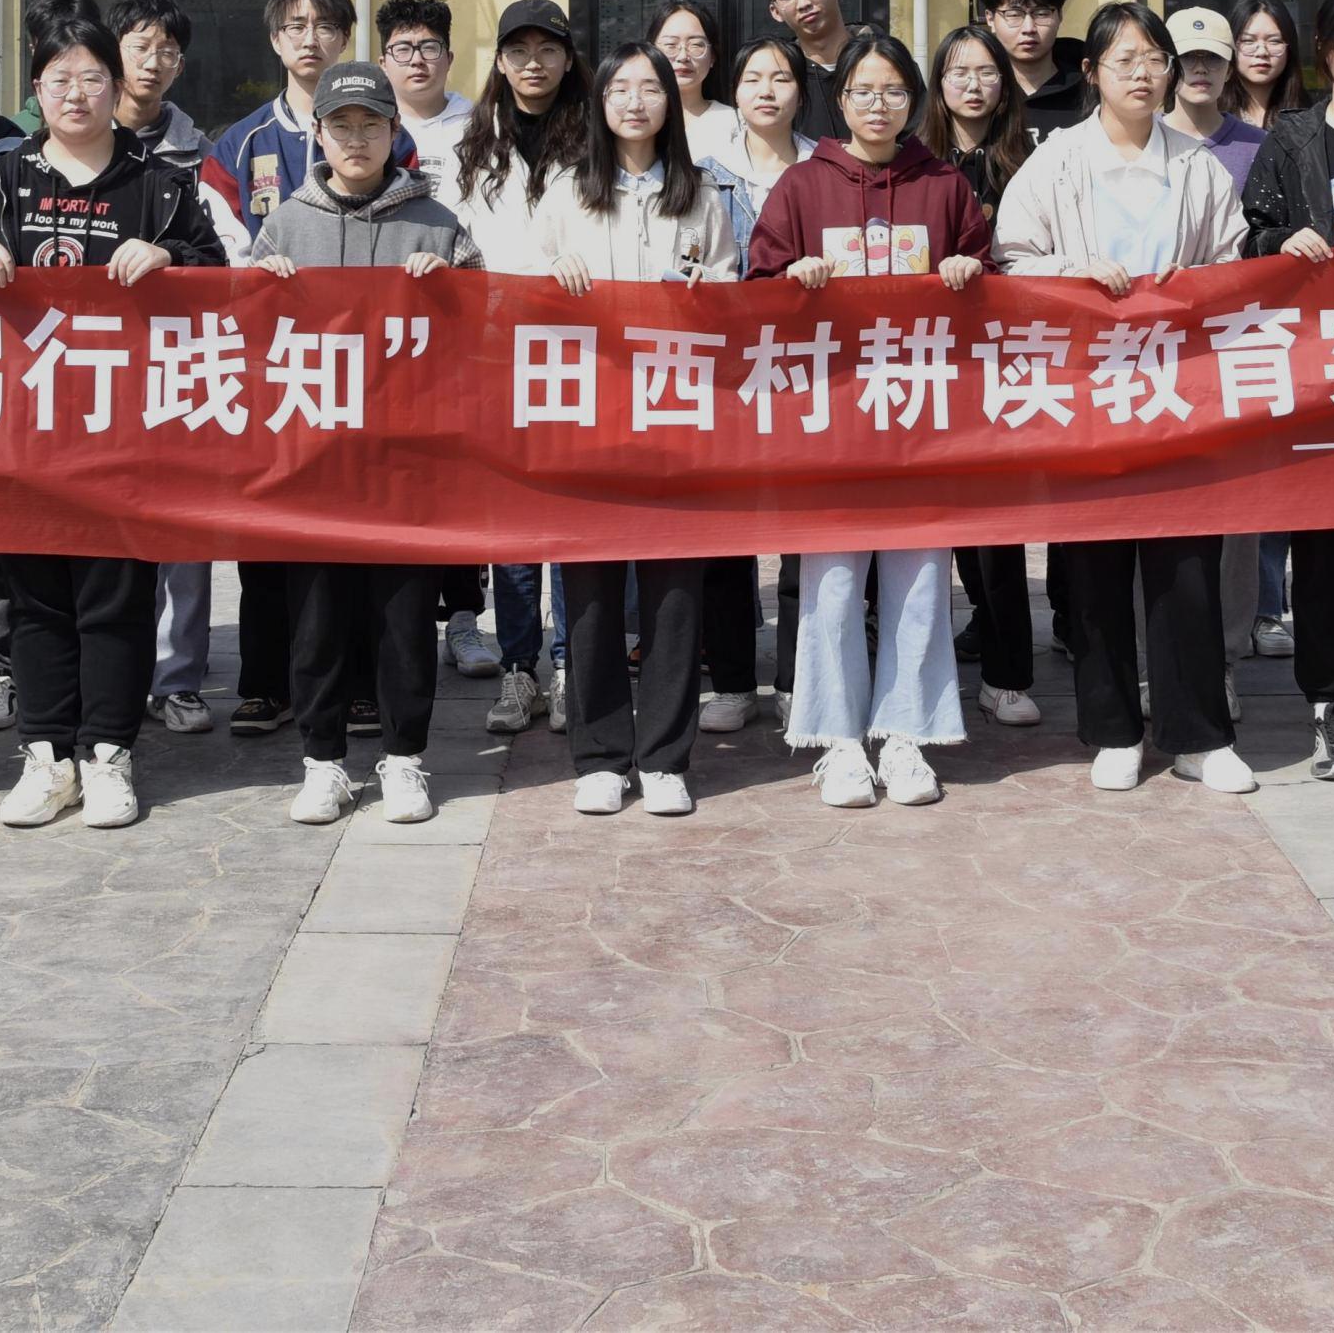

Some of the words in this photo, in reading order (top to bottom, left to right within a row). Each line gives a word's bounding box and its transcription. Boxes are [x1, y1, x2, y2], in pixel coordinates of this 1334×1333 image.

[35, 214, 65, 225] loos
[69, 217, 86, 228] my
[91, 219, 118, 231] work
